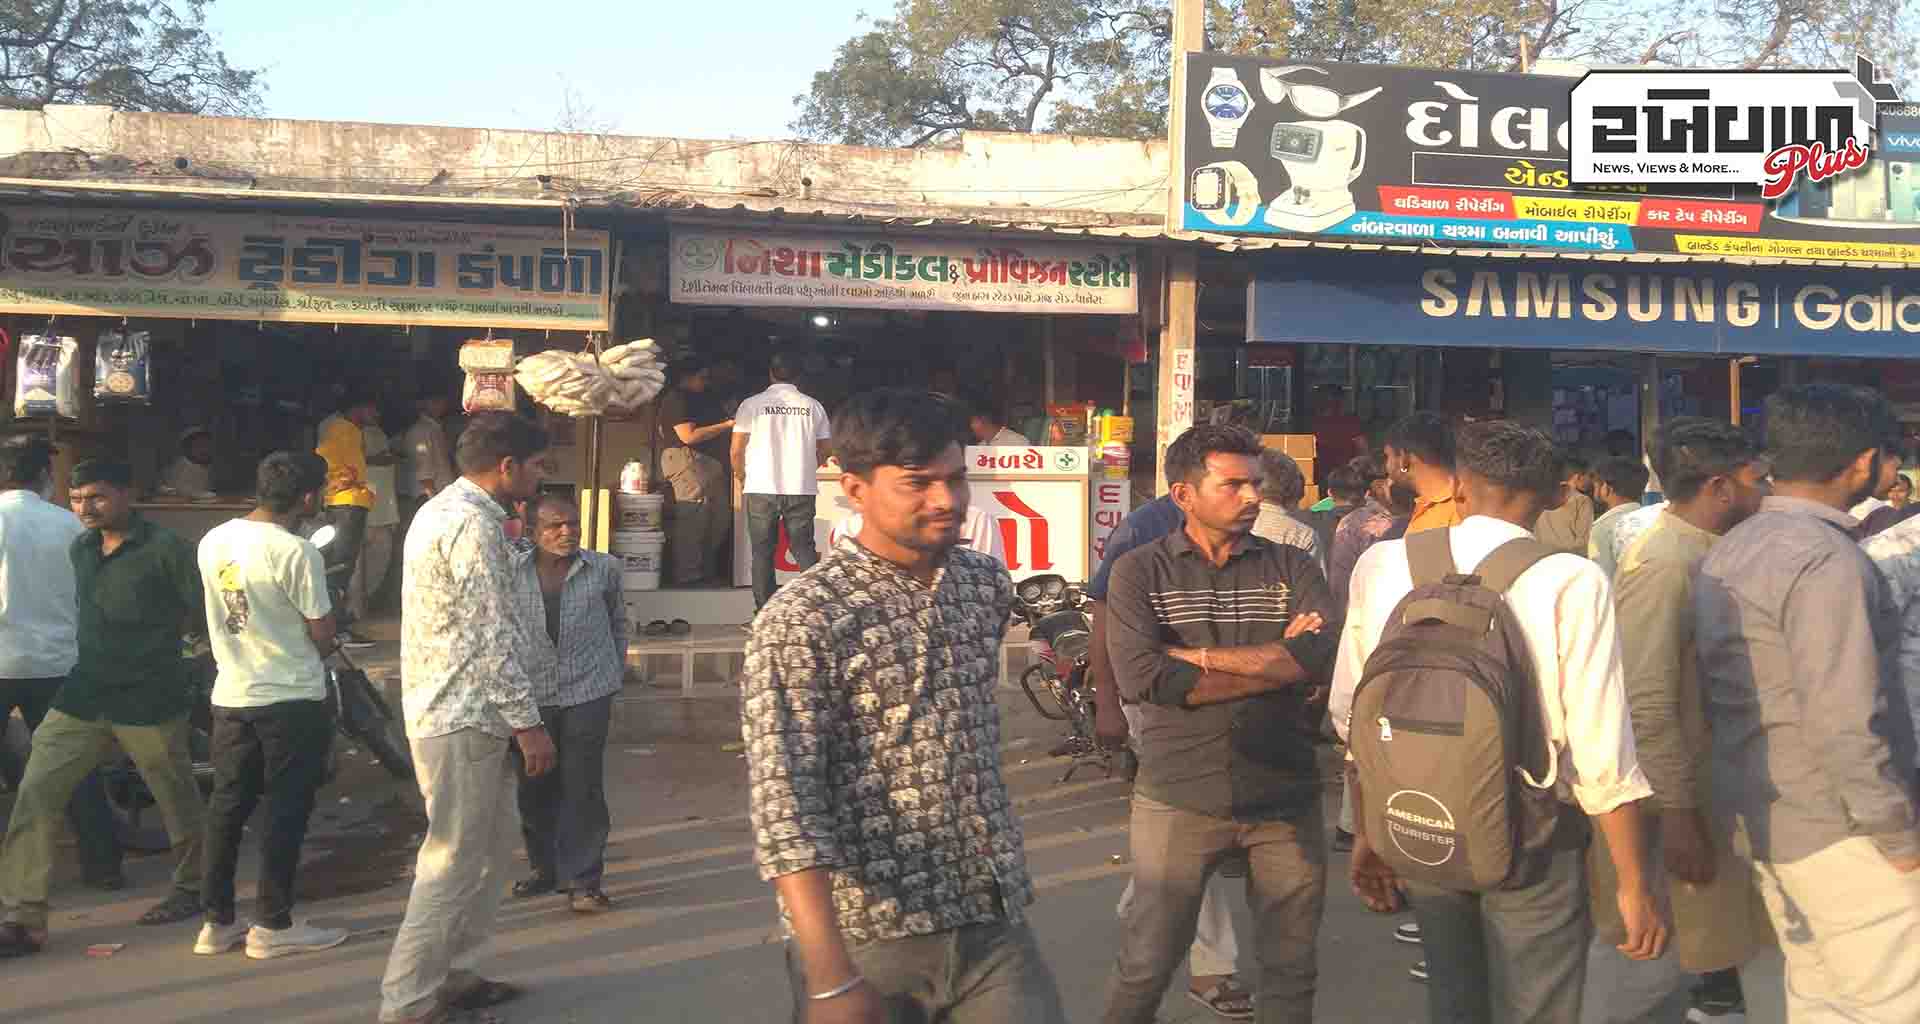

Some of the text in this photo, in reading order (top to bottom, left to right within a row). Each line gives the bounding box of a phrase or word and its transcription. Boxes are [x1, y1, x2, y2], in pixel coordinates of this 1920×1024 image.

[1405, 80, 1569, 152] દોલ
[1647, 209, 1671, 221] કાર
[1675, 208, 1695, 222] ટેપ
[1351, 218, 1435, 238] નંબરવાળા
[1492, 224, 1548, 241] બનાવી
[458, 243, 603, 293] કંપની
[722, 239, 821, 278] નિશા
[1420, 269, 1762, 327] SAMSUNG
[764, 406, 811, 417] NARCOTICS
[976, 448, 1043, 470] મળશે
[1386, 807, 1456, 831] AMERICAN
[1386, 819, 1456, 846] TOURISTER
